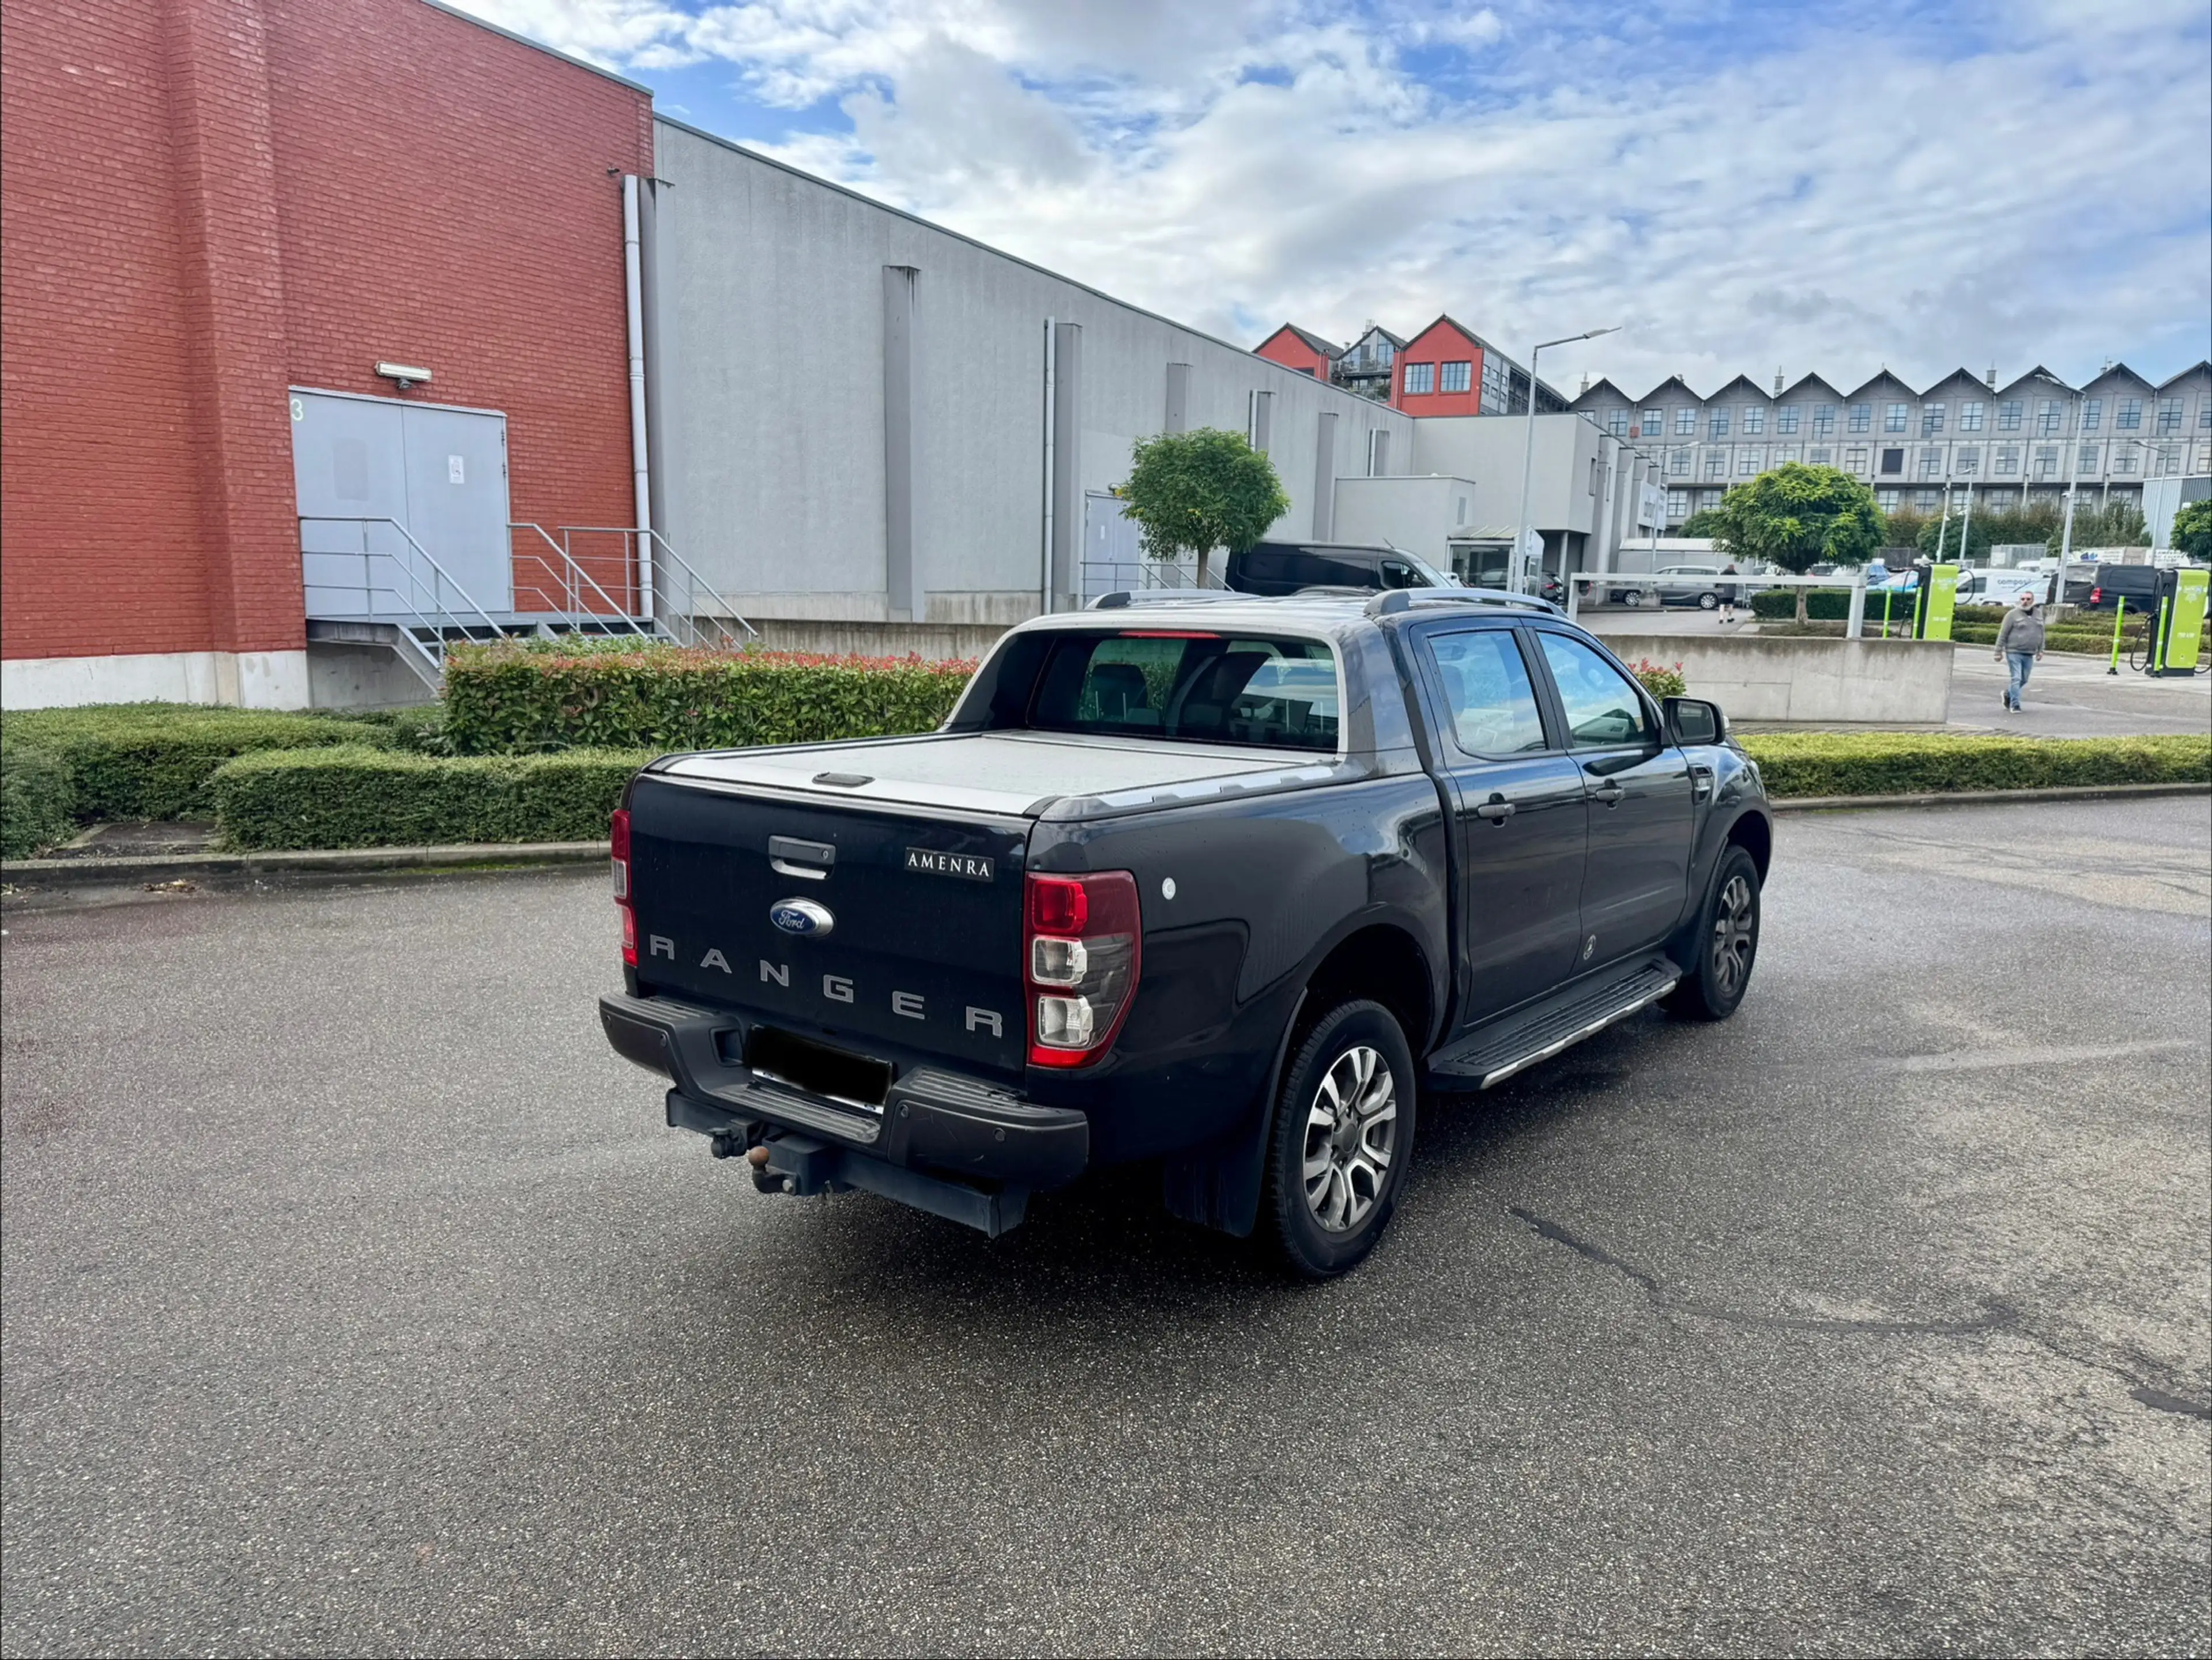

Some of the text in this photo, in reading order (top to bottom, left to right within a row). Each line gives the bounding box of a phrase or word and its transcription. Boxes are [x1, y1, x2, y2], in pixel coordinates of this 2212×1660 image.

[290, 398, 303, 421] 3
[908, 852, 989, 877] AMENRA
[778, 909, 805, 930] Ford
[649, 934, 1003, 1038] RANGER
